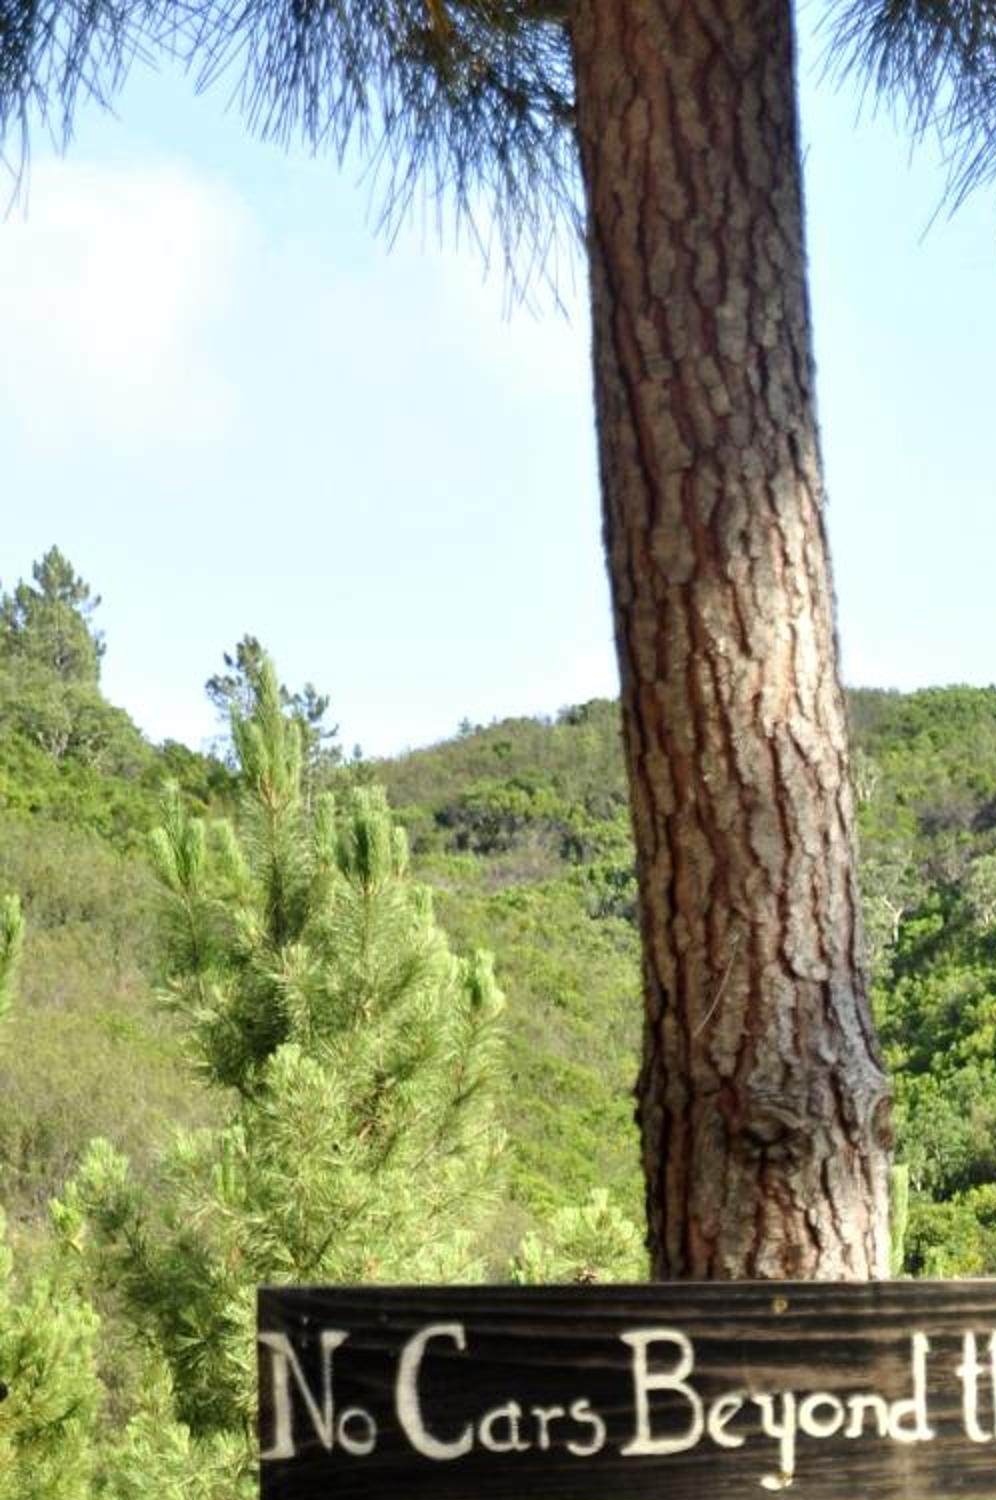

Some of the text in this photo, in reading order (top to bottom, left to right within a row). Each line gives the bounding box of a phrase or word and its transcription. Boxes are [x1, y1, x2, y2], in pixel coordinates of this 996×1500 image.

[258, 1330, 377, 1461] No
[395, 1322, 606, 1461] Cars
[619, 1326, 937, 1491] Beyond
